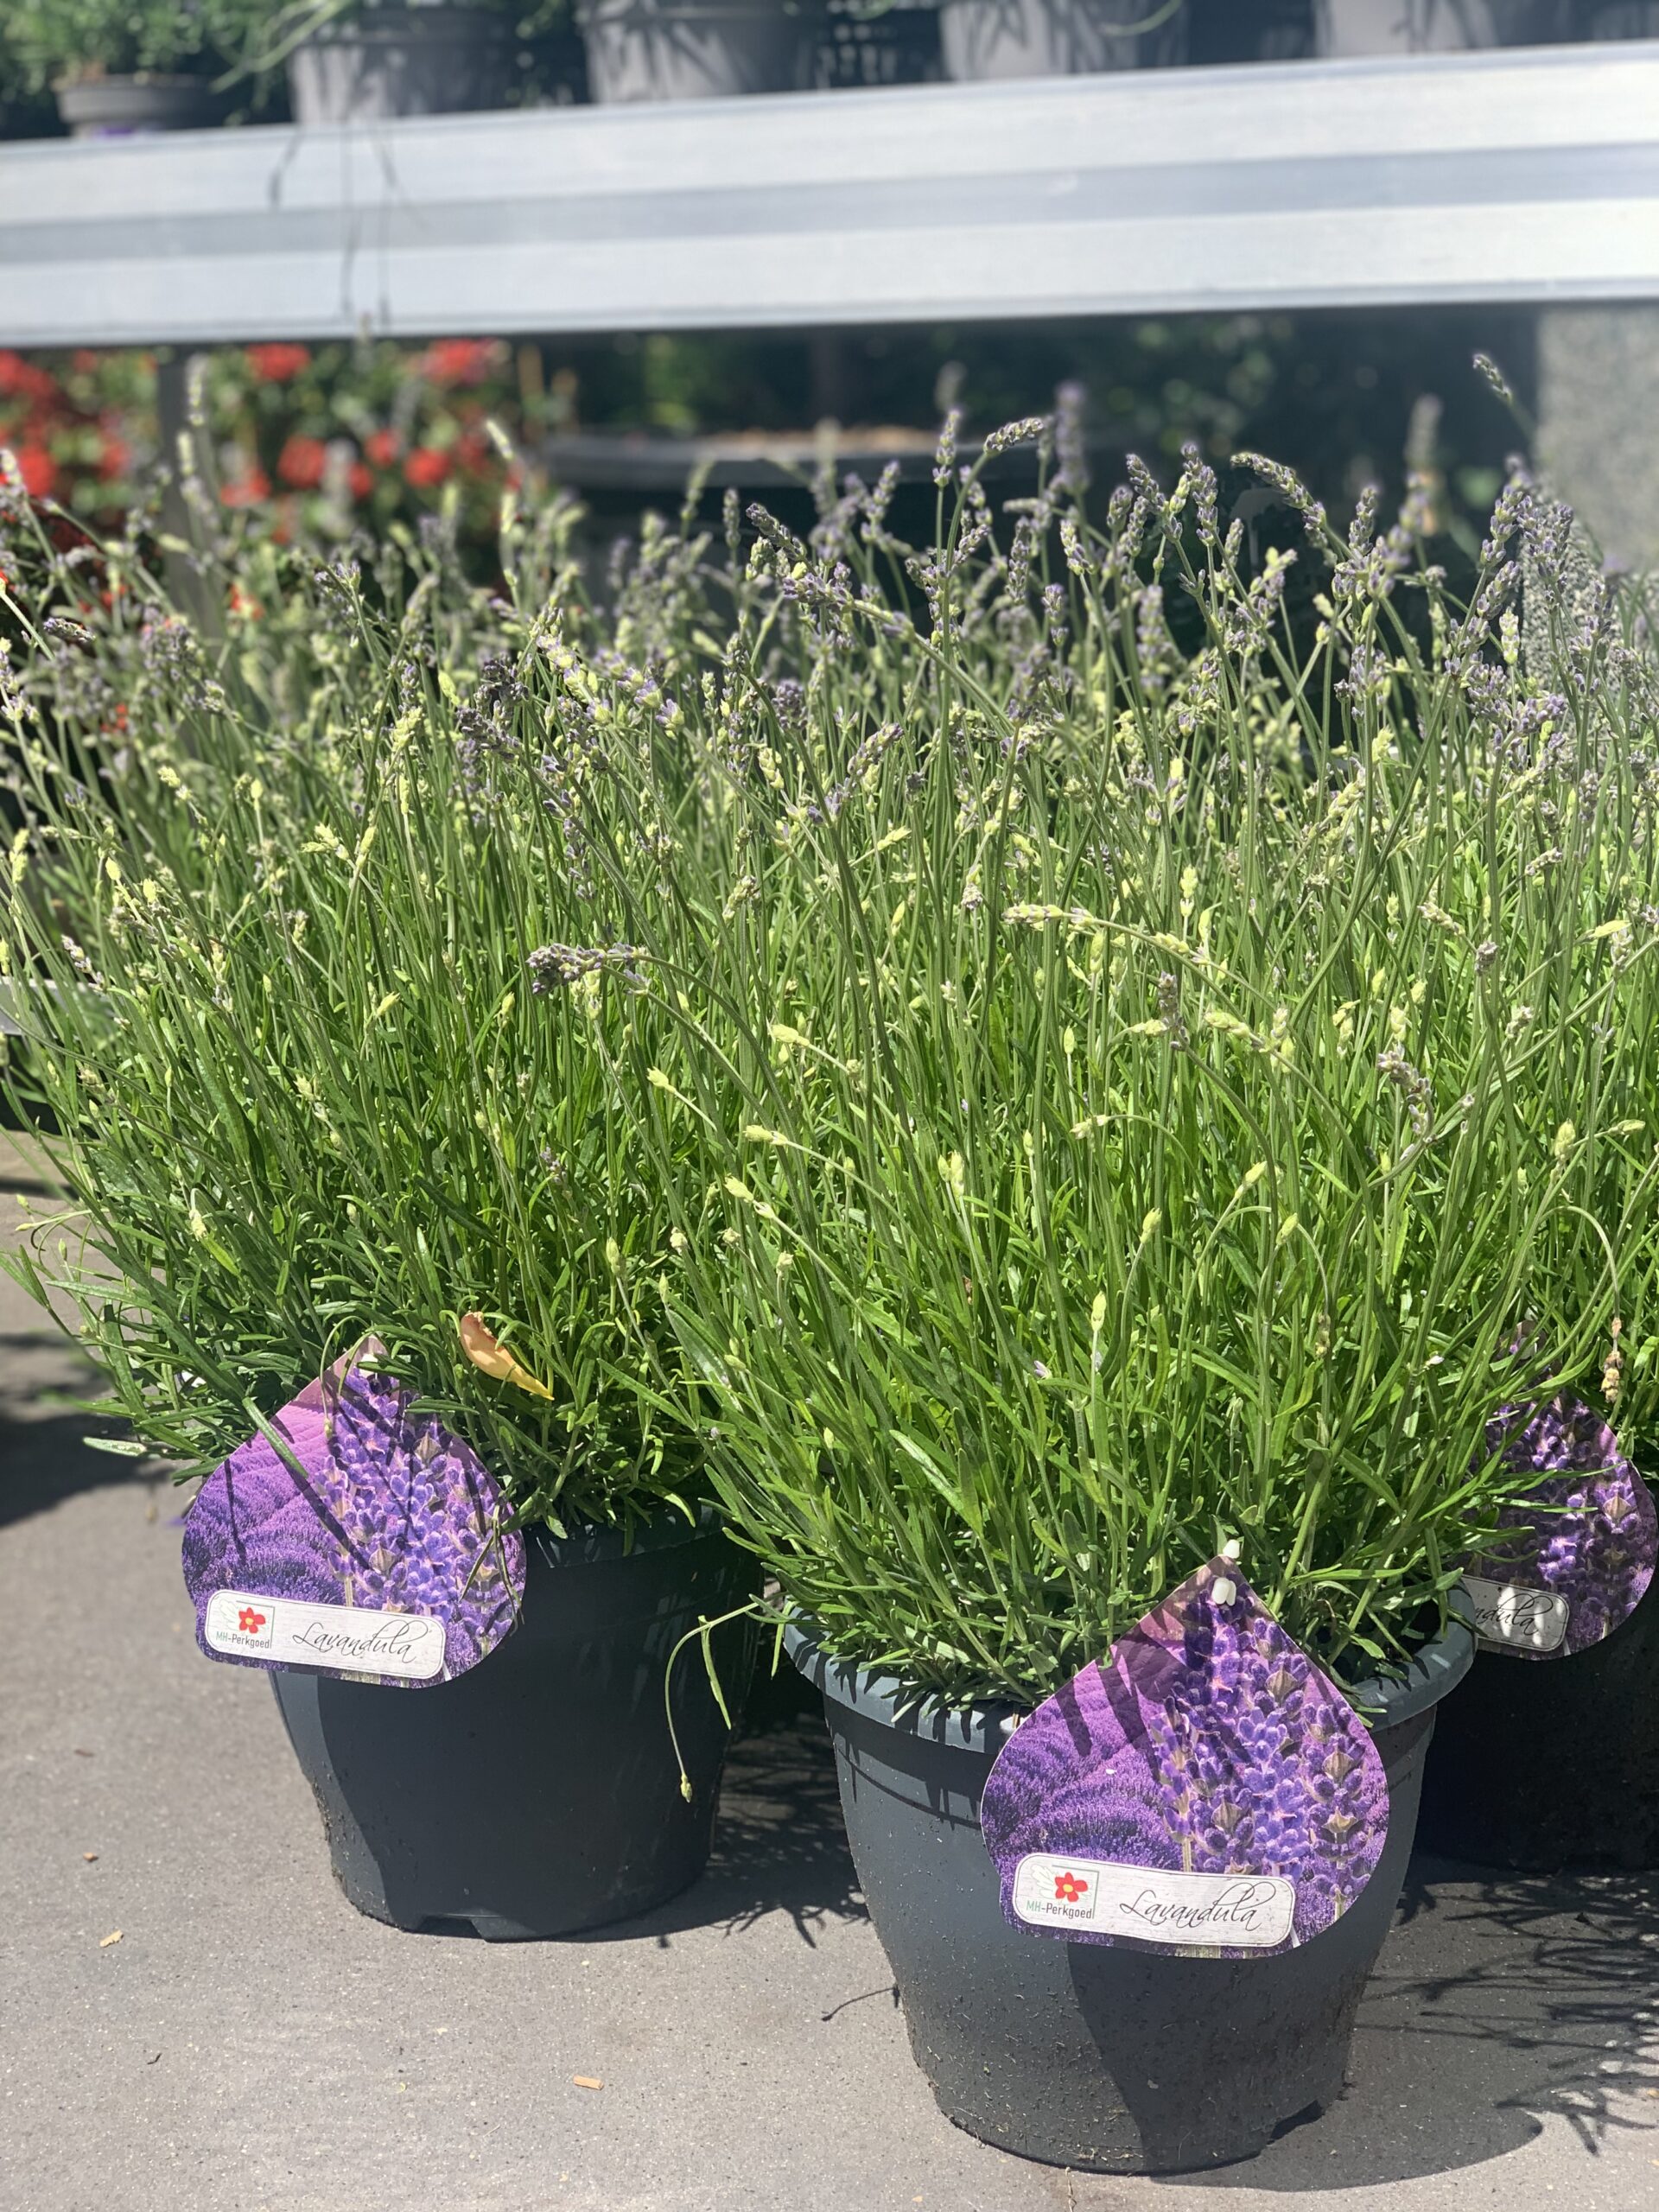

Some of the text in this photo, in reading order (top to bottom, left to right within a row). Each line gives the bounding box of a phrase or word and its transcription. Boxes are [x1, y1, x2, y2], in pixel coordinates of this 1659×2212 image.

[215, 1630, 270, 1649] MH-Perkgoed
[292, 1619, 429, 1664] Lavandula
[1026, 1900, 1092, 1919] MH-Perkgoed
[1119, 1881, 1277, 1932] Lavandula
